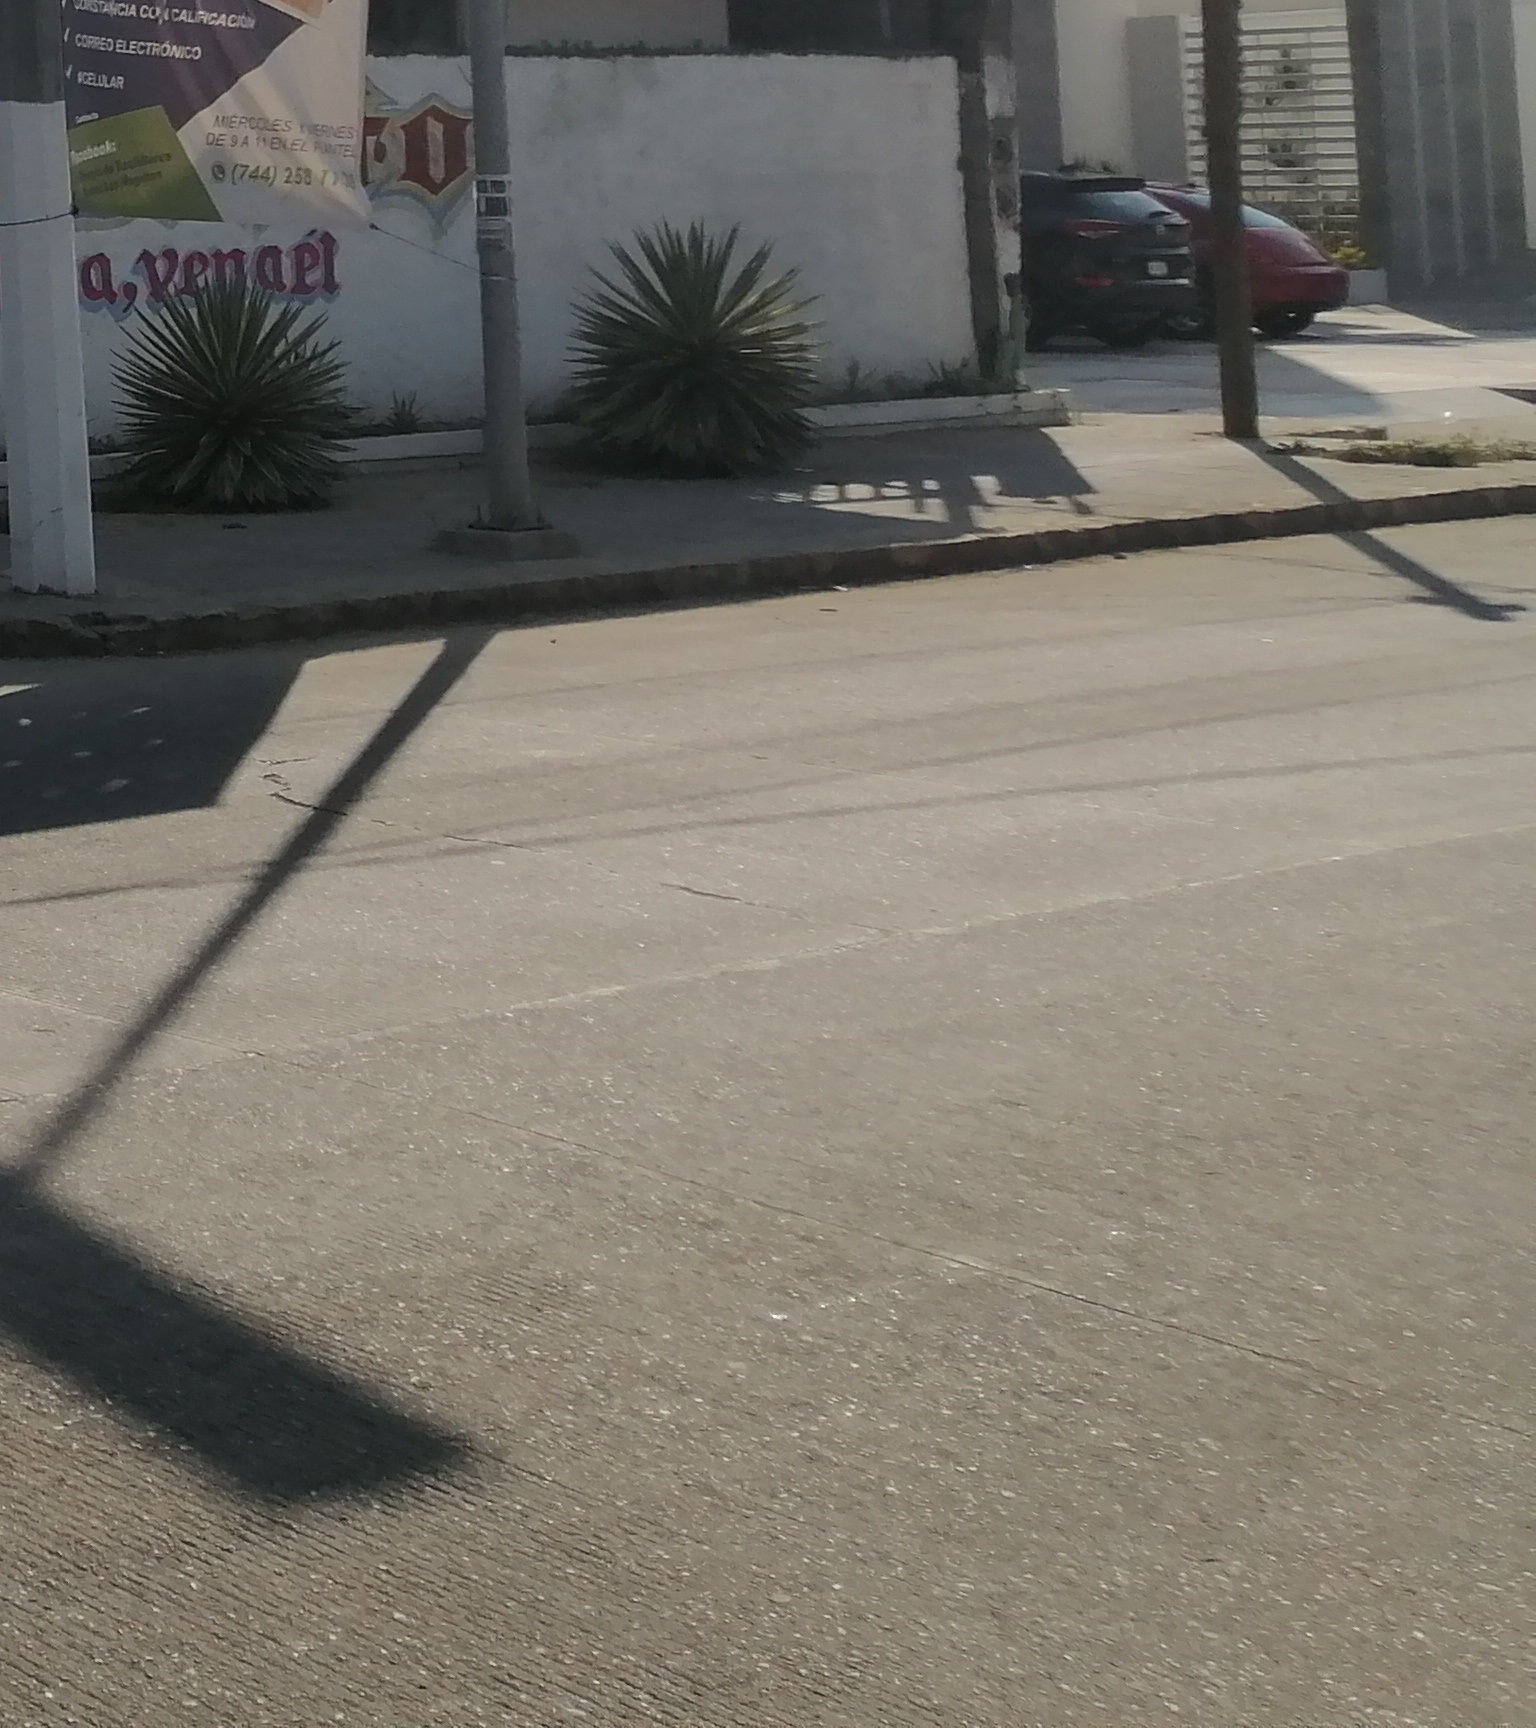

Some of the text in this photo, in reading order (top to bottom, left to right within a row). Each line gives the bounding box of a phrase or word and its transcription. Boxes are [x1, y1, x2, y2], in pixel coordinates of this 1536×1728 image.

[75, 33, 202, 61] CORREO ELECTRÓNICO
[206, 132, 227, 147] DE
[230, 134, 238, 148] 9
[241, 134, 249, 148] A
[232, 162, 277, 187] (744)
